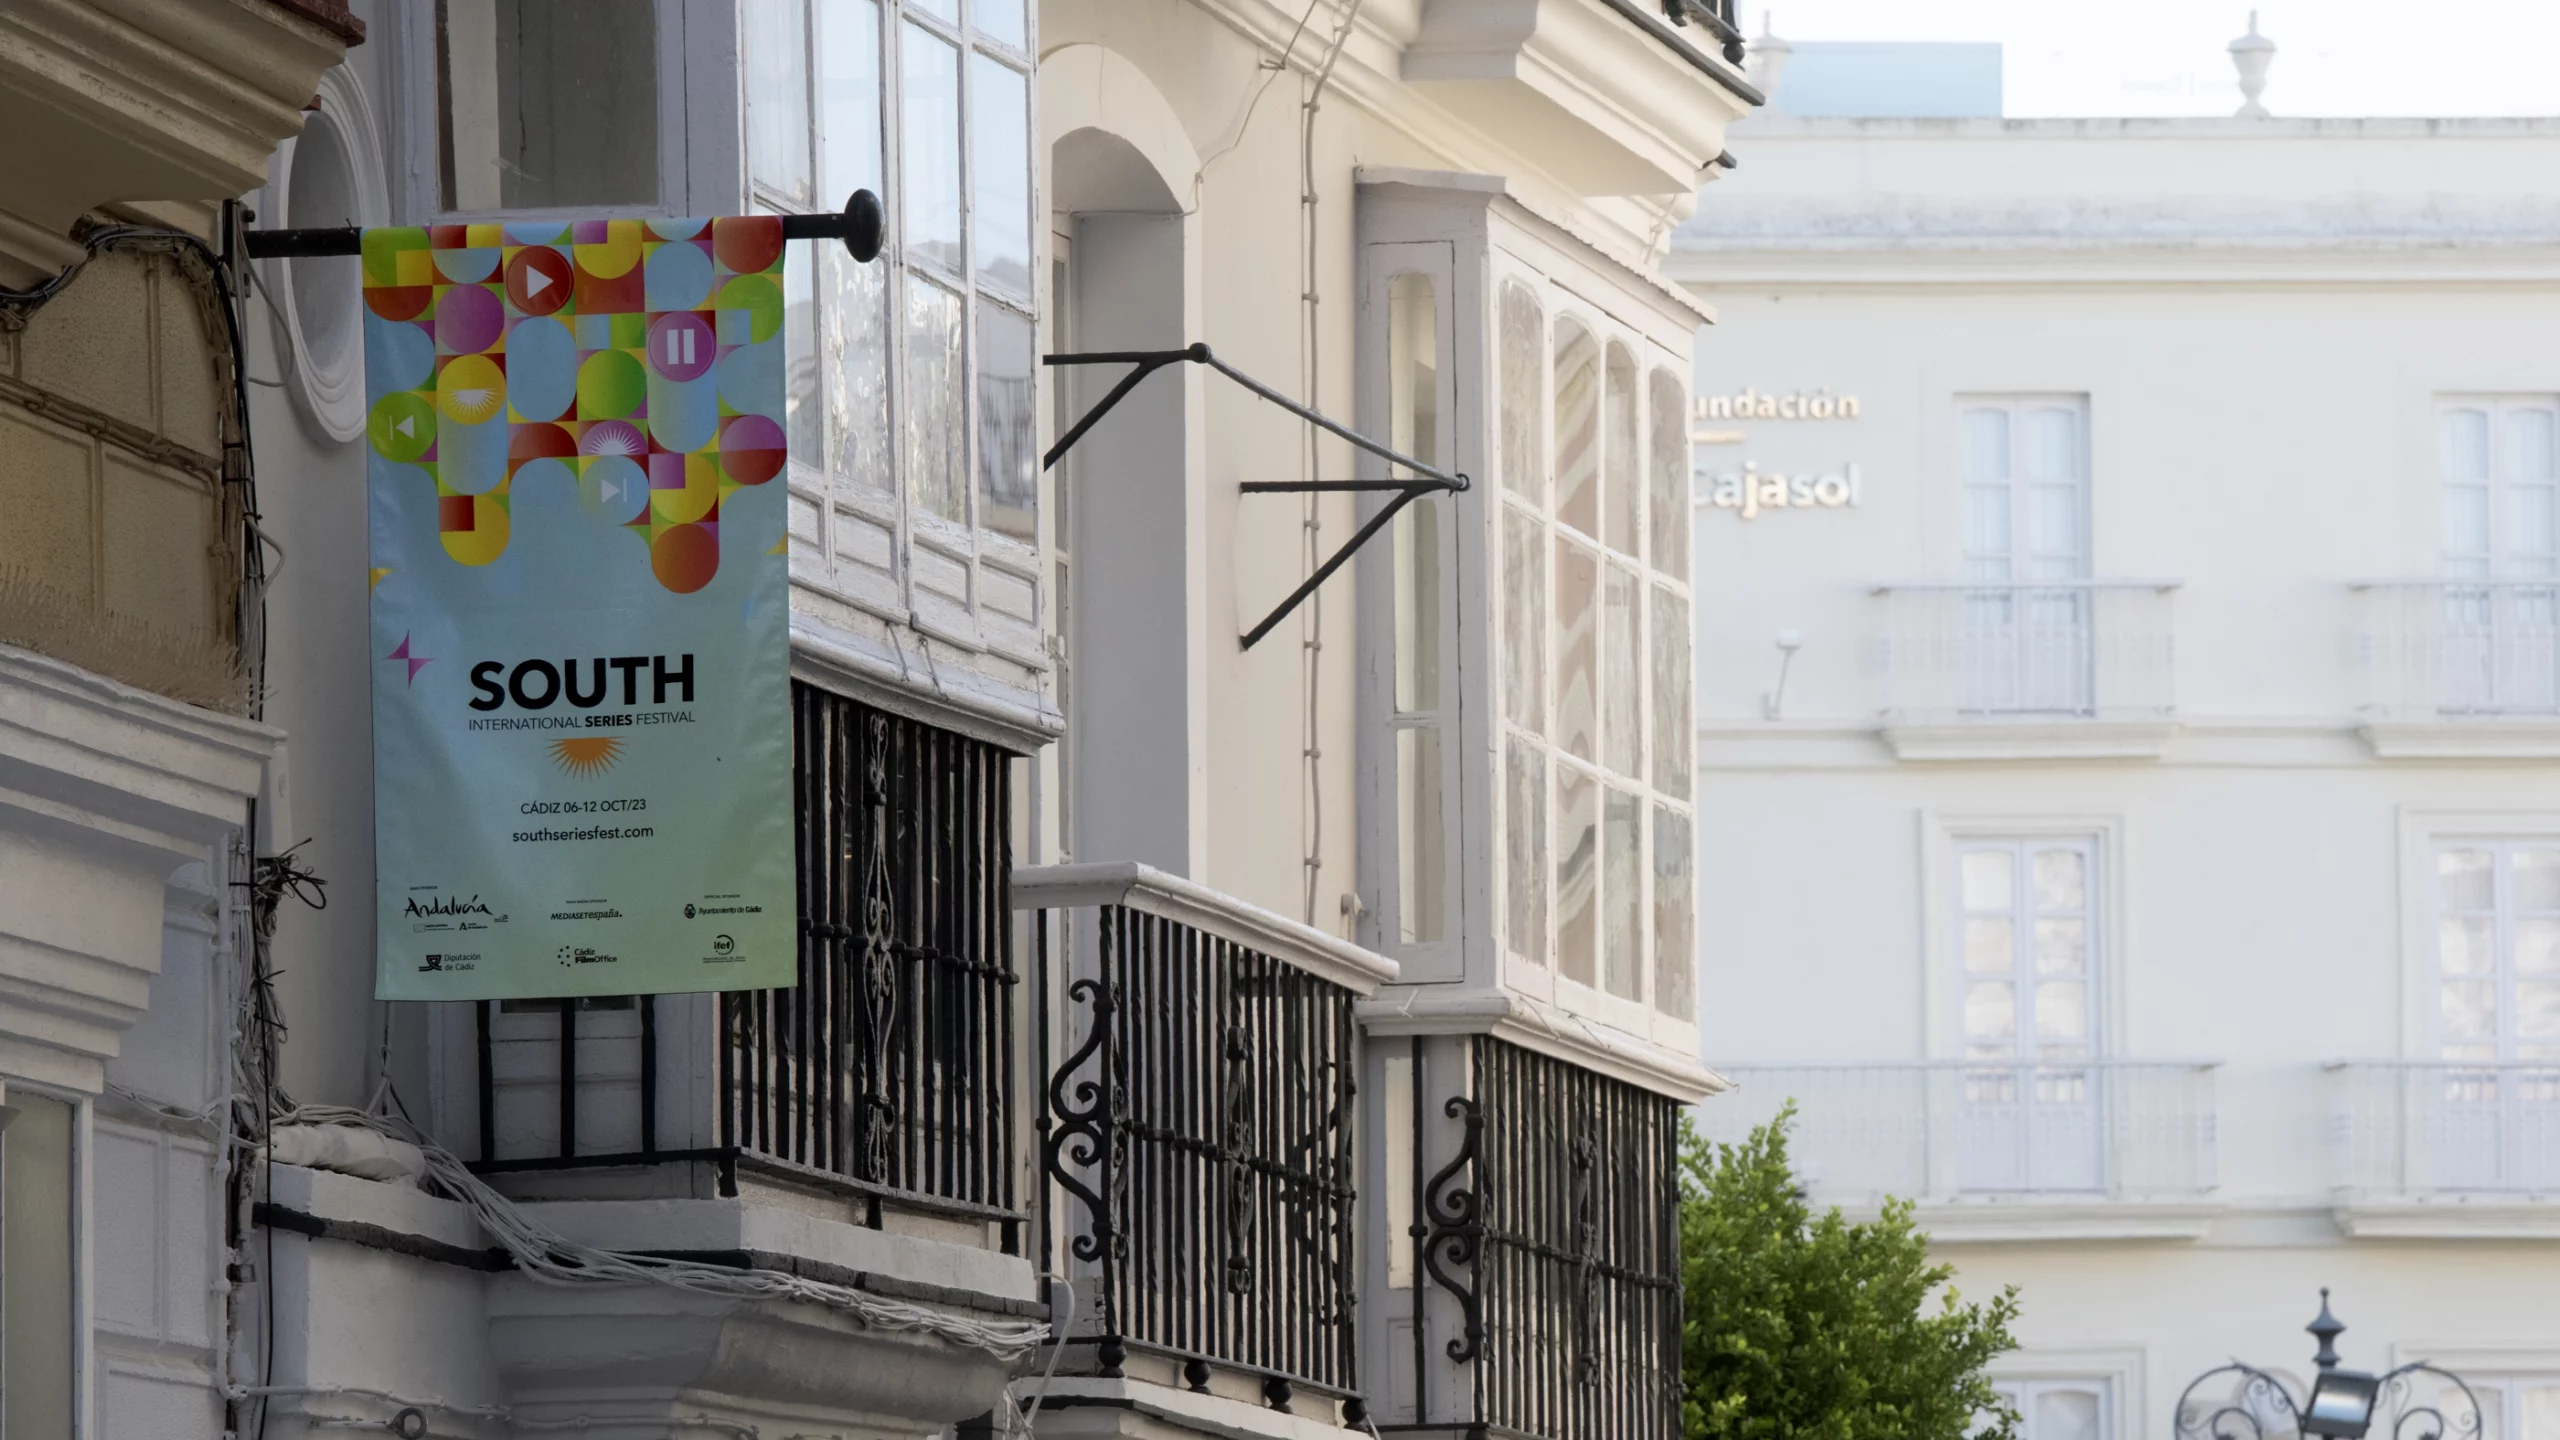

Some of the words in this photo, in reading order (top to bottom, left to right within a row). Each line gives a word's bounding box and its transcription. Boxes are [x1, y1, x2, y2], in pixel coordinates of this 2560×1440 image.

[1694, 386, 1860, 420] undación
[468, 654, 694, 711] SOUTH
[469, 716, 581, 731] INTERNATIONAL
[585, 714, 633, 728] SERIES
[636, 711, 696, 726] FESTIVAL
[521, 800, 561, 815] CÁDIZ
[563, 801, 597, 813] 06-12
[600, 798, 647, 812] OCT/23
[513, 825, 654, 843] southseriesfest.com
[403, 894, 494, 919] Andalucía
[444, 953, 481, 962] Diputación
[455, 963, 475, 971] Cádiz
